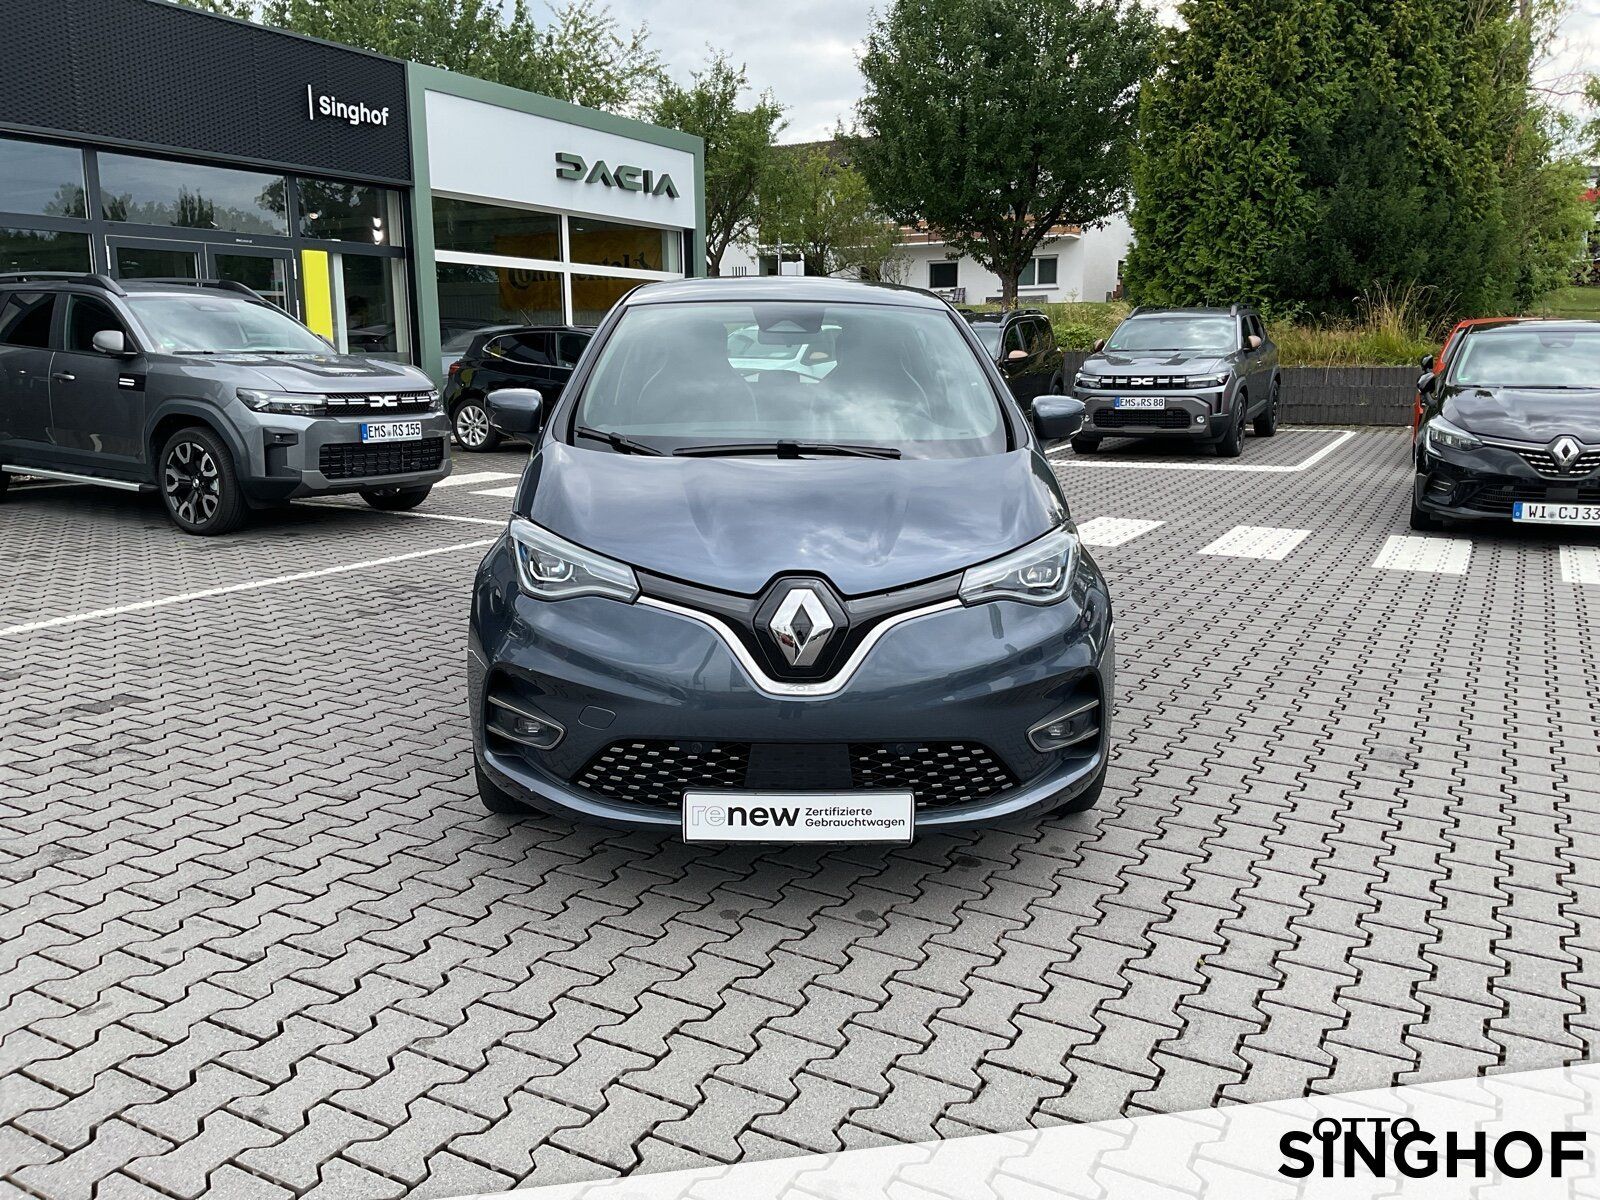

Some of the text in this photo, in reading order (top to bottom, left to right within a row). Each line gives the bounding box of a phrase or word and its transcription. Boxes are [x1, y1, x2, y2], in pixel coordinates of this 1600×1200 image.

[319, 95, 389, 126] Singhof
[555, 152, 680, 198] DACIA
[1120, 398, 1136, 407] EMS
[1140, 398, 1152, 407] RS
[368, 423, 421, 438] EMS RS 155
[1529, 505, 1547, 518] WI
[1559, 507, 1579, 520] CJ
[691, 804, 800, 827] renew
[805, 806, 873, 817] Zertifizierte
[805, 817, 905, 829] Gebrauchtwagen
